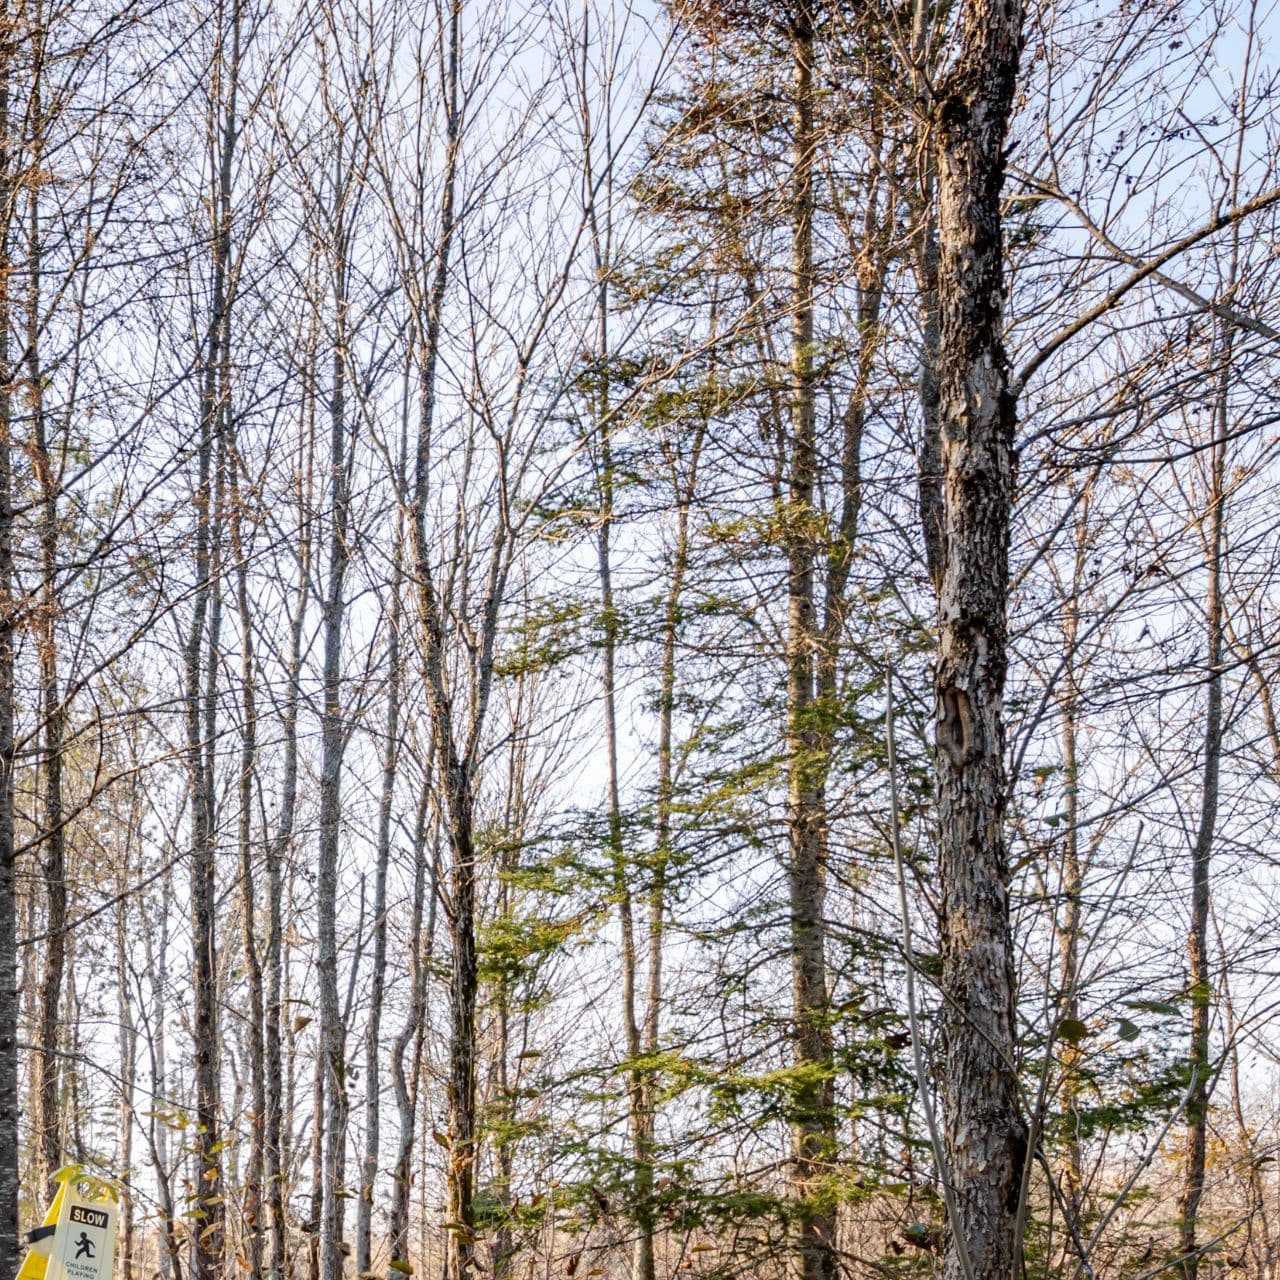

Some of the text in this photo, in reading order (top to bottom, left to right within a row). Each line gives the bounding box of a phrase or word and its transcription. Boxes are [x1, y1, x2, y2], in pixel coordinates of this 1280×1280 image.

[73, 1209, 105, 1226] SLOW
[65, 1261, 98, 1273] CHILDREN
[67, 1268, 95, 1280] PLAYING
